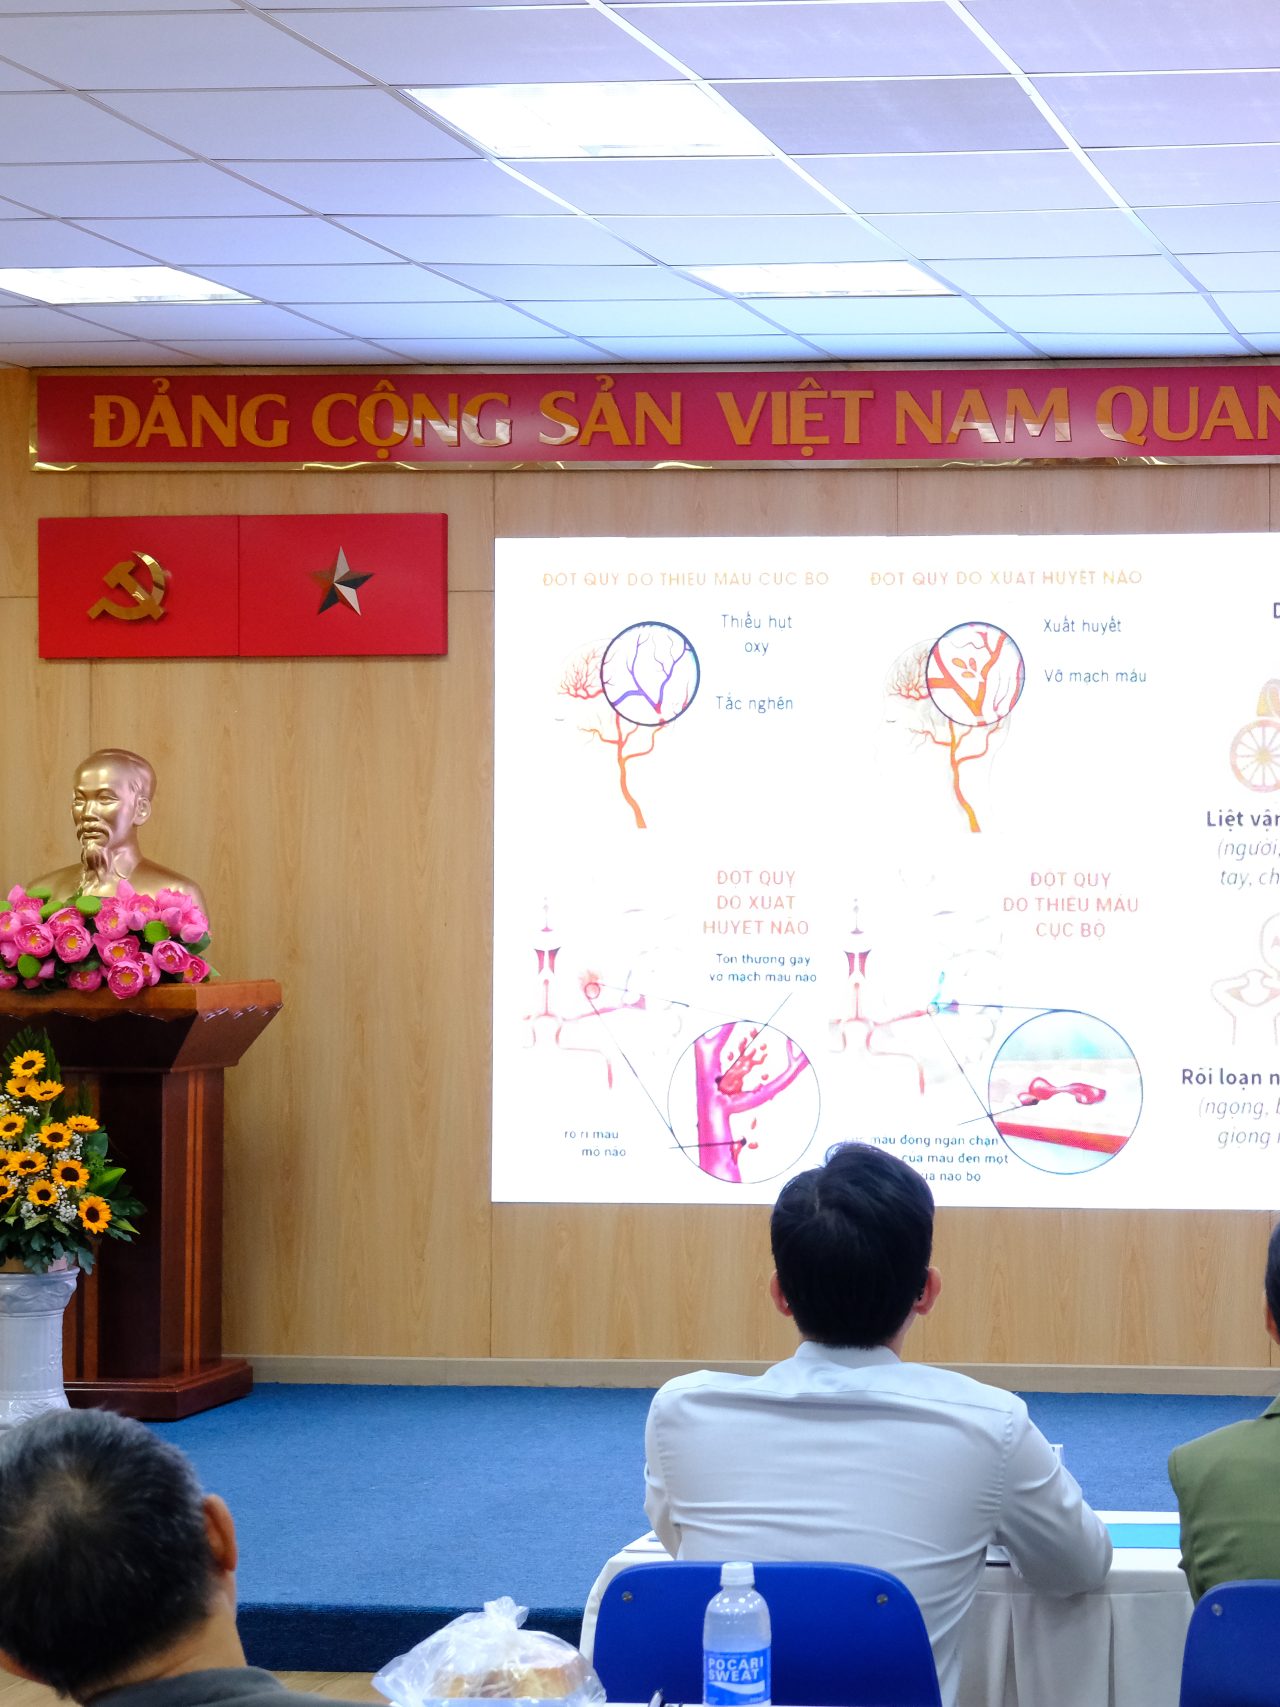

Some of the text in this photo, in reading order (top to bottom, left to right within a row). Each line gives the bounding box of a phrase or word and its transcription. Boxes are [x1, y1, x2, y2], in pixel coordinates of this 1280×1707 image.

[90, 377, 289, 448] ĐẢNG
[311, 379, 513, 459] CỘNG
[539, 374, 682, 447] SẢN
[716, 377, 874, 456] VIỆT
[896, 387, 1071, 444] NAM
[627, 572, 654, 586] DO
[956, 570, 983, 585] DO
[744, 642, 769, 657] oxy
[1206, 809, 1244, 832] Liệt
[717, 895, 742, 910] DO
[1002, 896, 1028, 912] DO
[1219, 1067, 1262, 1090] loạn
[708, 1656, 764, 1671] POCARI
[708, 1668, 760, 1682] SWEAT
